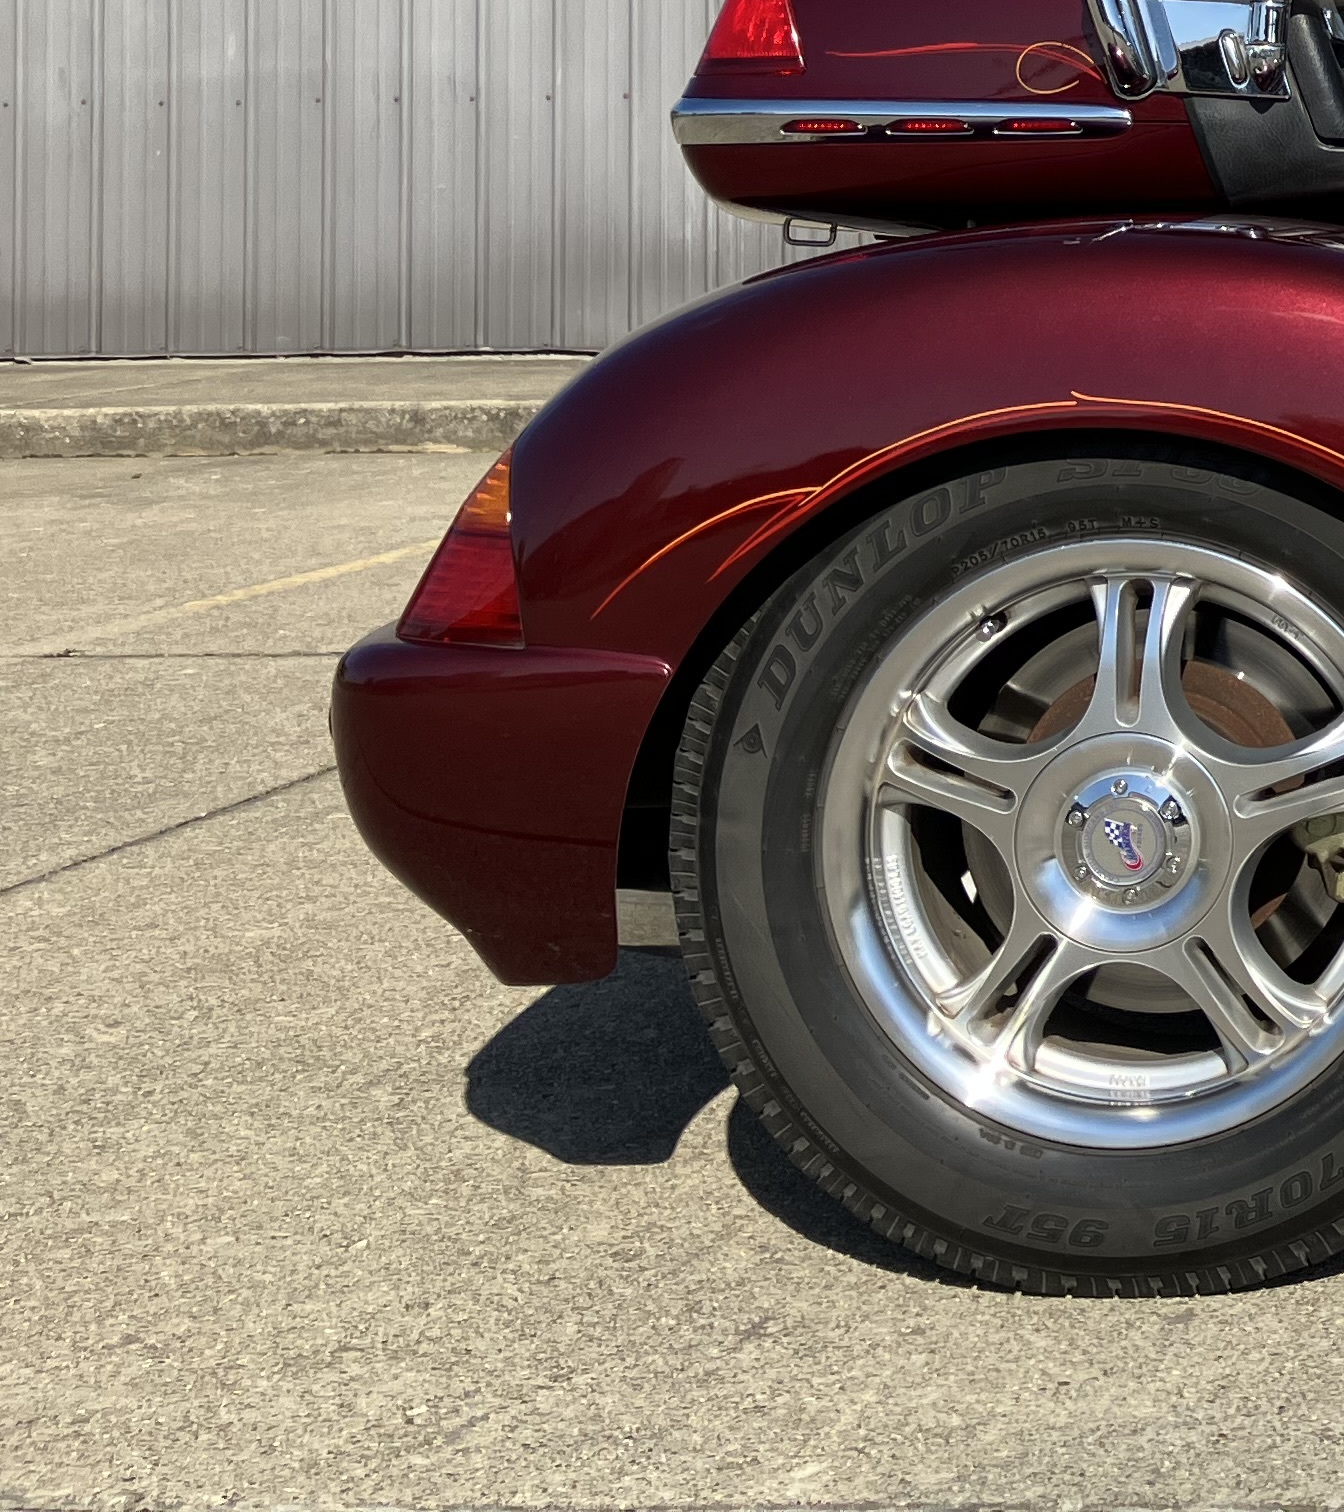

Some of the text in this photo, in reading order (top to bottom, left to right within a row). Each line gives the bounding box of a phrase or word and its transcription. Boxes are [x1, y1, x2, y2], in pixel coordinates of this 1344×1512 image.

[951, 526, 1048, 577] P205/70R15
[757, 465, 1009, 712] DUNLOP
[983, 1203, 1110, 1250] 95T
